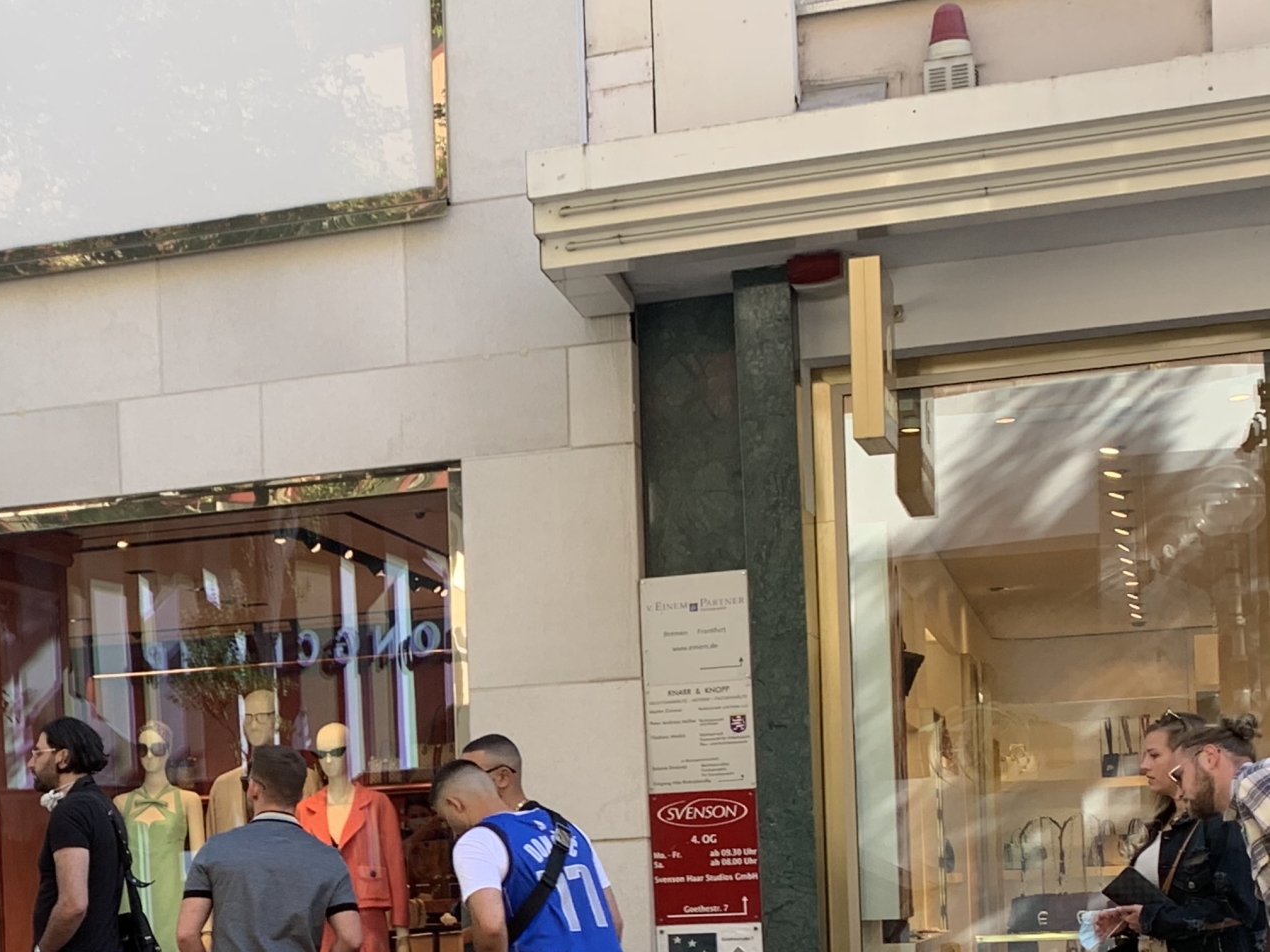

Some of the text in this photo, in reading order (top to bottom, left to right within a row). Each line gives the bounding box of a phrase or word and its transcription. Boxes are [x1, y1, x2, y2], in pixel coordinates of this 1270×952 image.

[700, 597, 745, 608] PARTNER
[666, 804, 738, 821] SVENSON
[690, 834, 718, 845] 4. OG
[710, 849, 720, 857] ab
[743, 848, 758, 856] Uhr
[710, 859, 720, 867] ab
[744, 857, 758, 865] Uhr
[654, 872, 759, 884] Svenson Haar Studios GmbH
[683, 905, 723, 914] Goethestr.
